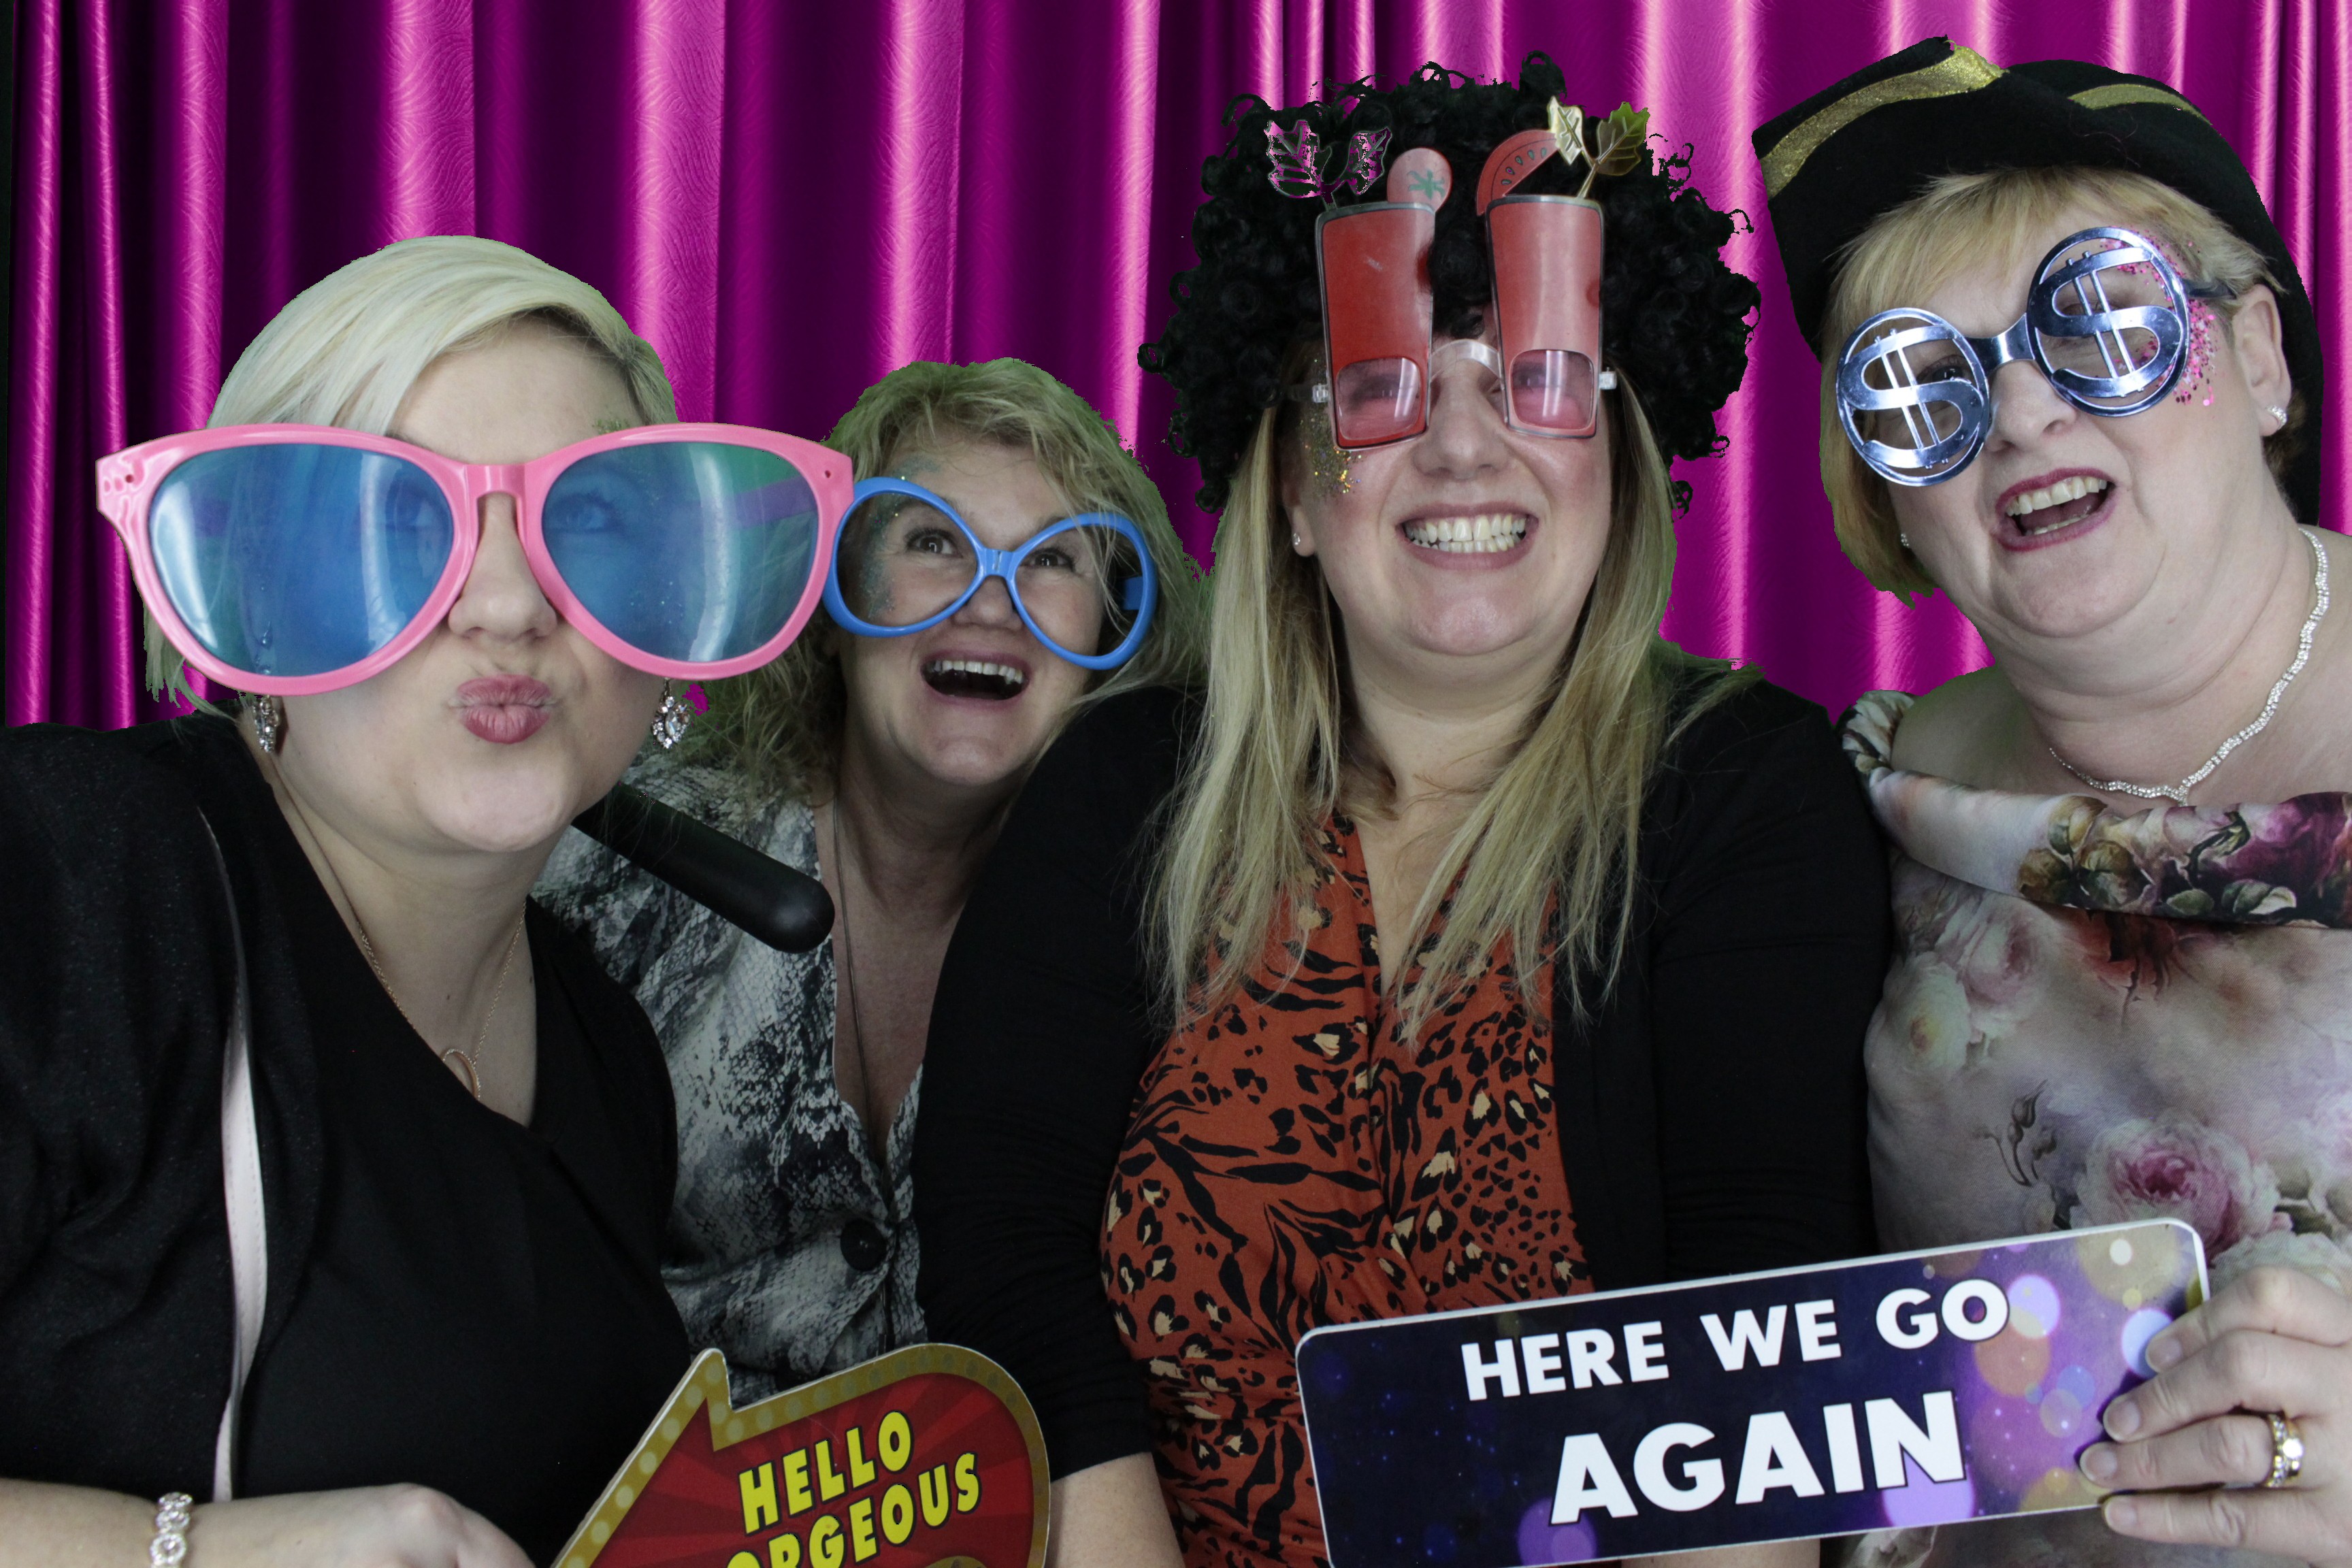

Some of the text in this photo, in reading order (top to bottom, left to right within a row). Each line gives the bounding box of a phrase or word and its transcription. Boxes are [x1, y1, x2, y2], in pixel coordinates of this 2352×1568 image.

[1461, 1279, 2008, 1401] HERE WE GO
[725, 1454, 979, 1568] RGEOUS
[739, 1412, 911, 1533] HELLO
[1551, 1391, 1964, 1524] AGAIN
